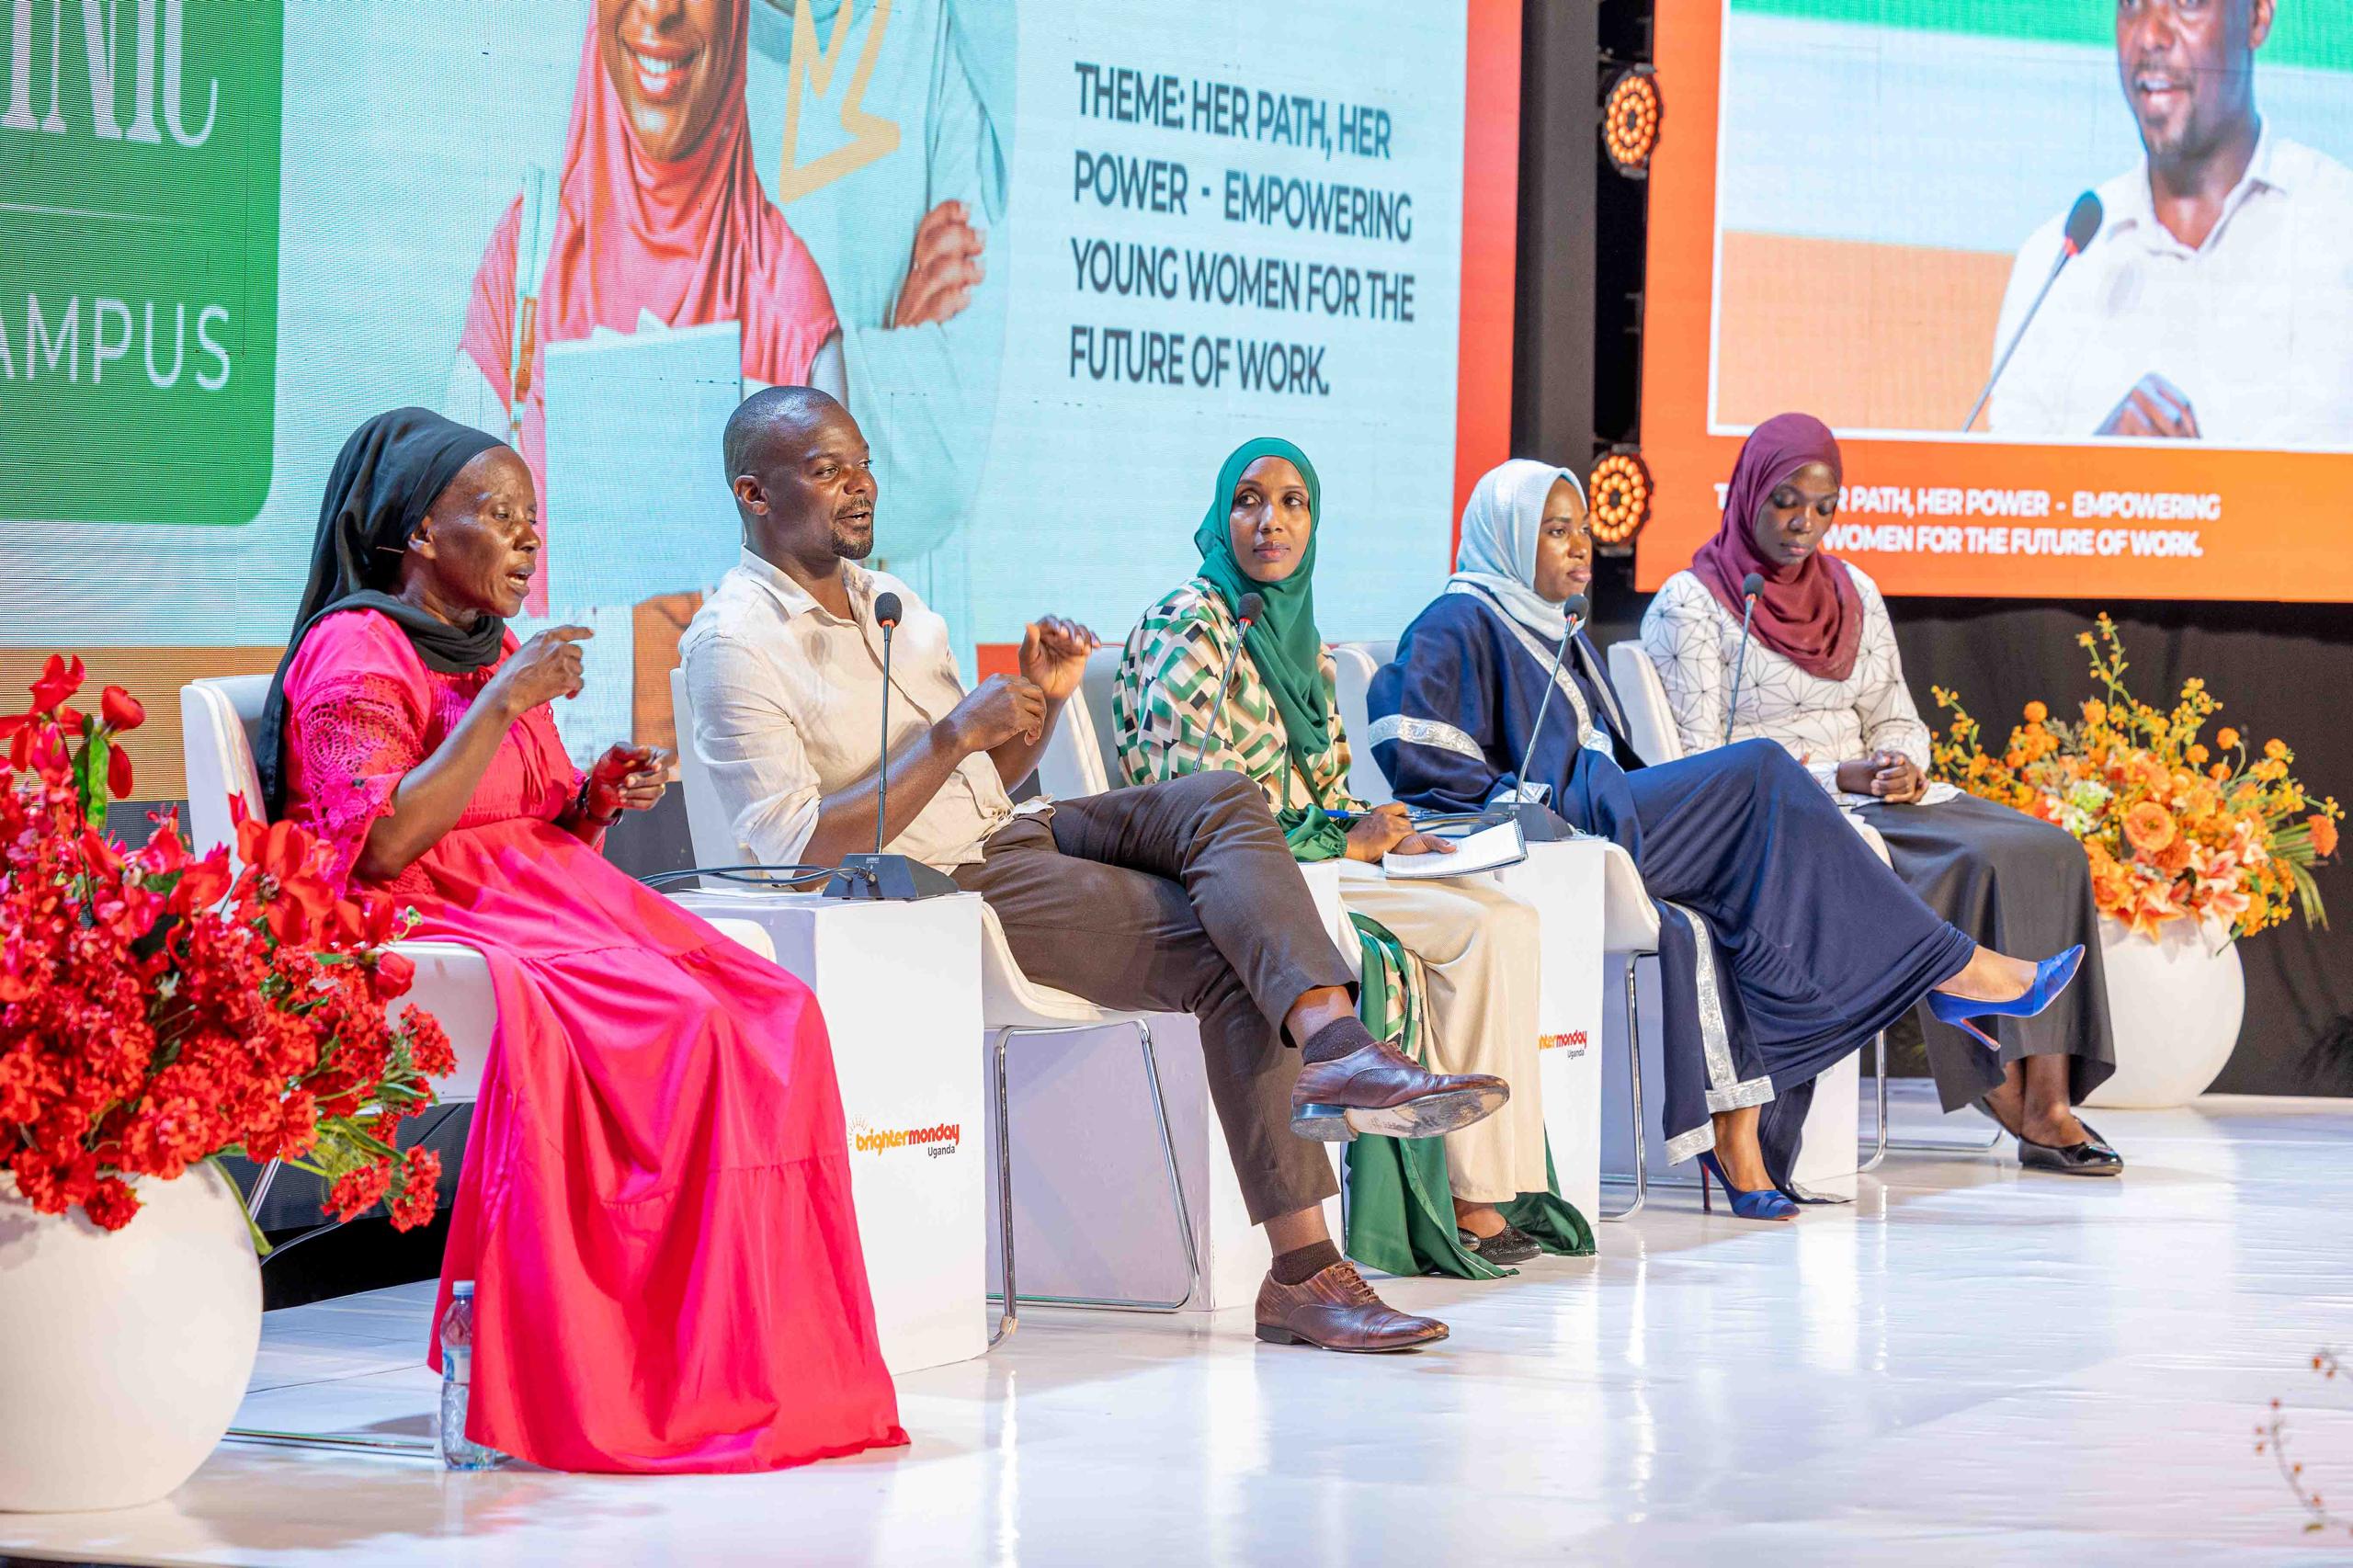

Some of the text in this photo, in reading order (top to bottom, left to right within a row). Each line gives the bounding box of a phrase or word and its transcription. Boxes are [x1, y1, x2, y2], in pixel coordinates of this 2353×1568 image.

[1074, 61, 1392, 161] THEME: HER PATH, HER
[1074, 149, 1188, 215] POWER
[1224, 169, 1413, 243] EMPOWERING
[1072, 237, 1415, 323] YOUNG WOMEN FOR THE
[1070, 324, 1329, 396] FUTURE OF WORK.
[1850, 485, 1914, 518] PATH,
[1916, 487, 1963, 515] HER
[1965, 488, 2051, 517] POWER
[2072, 490, 2222, 520] EMPOWERING
[1823, 523, 2204, 558] WOMEN FOR THE FUTURE OF WORK.
[927, 1143, 956, 1159] Uganda
